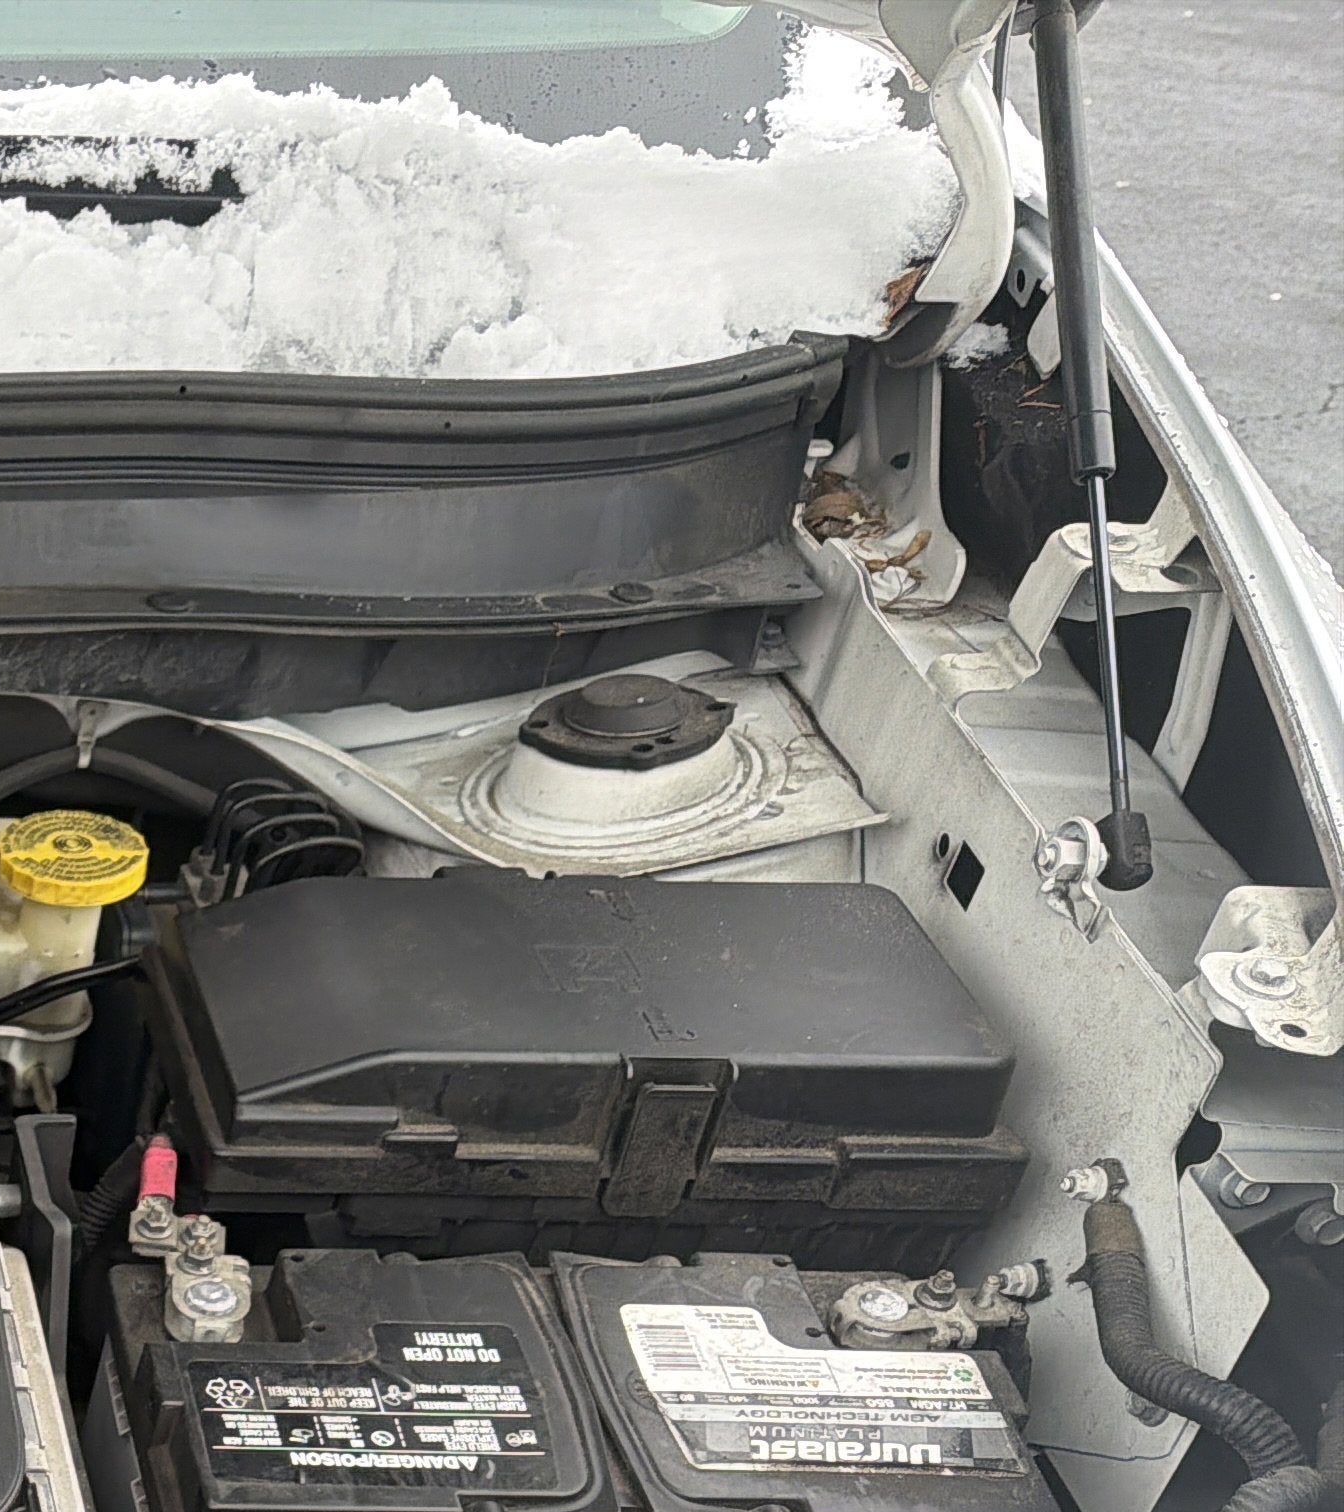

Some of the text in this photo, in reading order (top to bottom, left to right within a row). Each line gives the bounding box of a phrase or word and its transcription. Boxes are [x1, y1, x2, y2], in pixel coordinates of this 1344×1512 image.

[413, 1332, 484, 1347] BATTERY!
[402, 1347, 501, 1362] DO NOT OPEN
[322, 1387, 335, 1397] OF
[337, 1387, 372, 1397] REACH
[287, 1397, 377, 1408] KEEP OUT OF THE
[866, 1399, 894, 1409] 850
[735, 1409, 941, 1423] AGM TECHNOLOGY
[749, 1425, 881, 1439] PLATINUM
[750, 1439, 942, 1465] Duralast
[290, 1452, 460, 1469] DANGER/POISON
